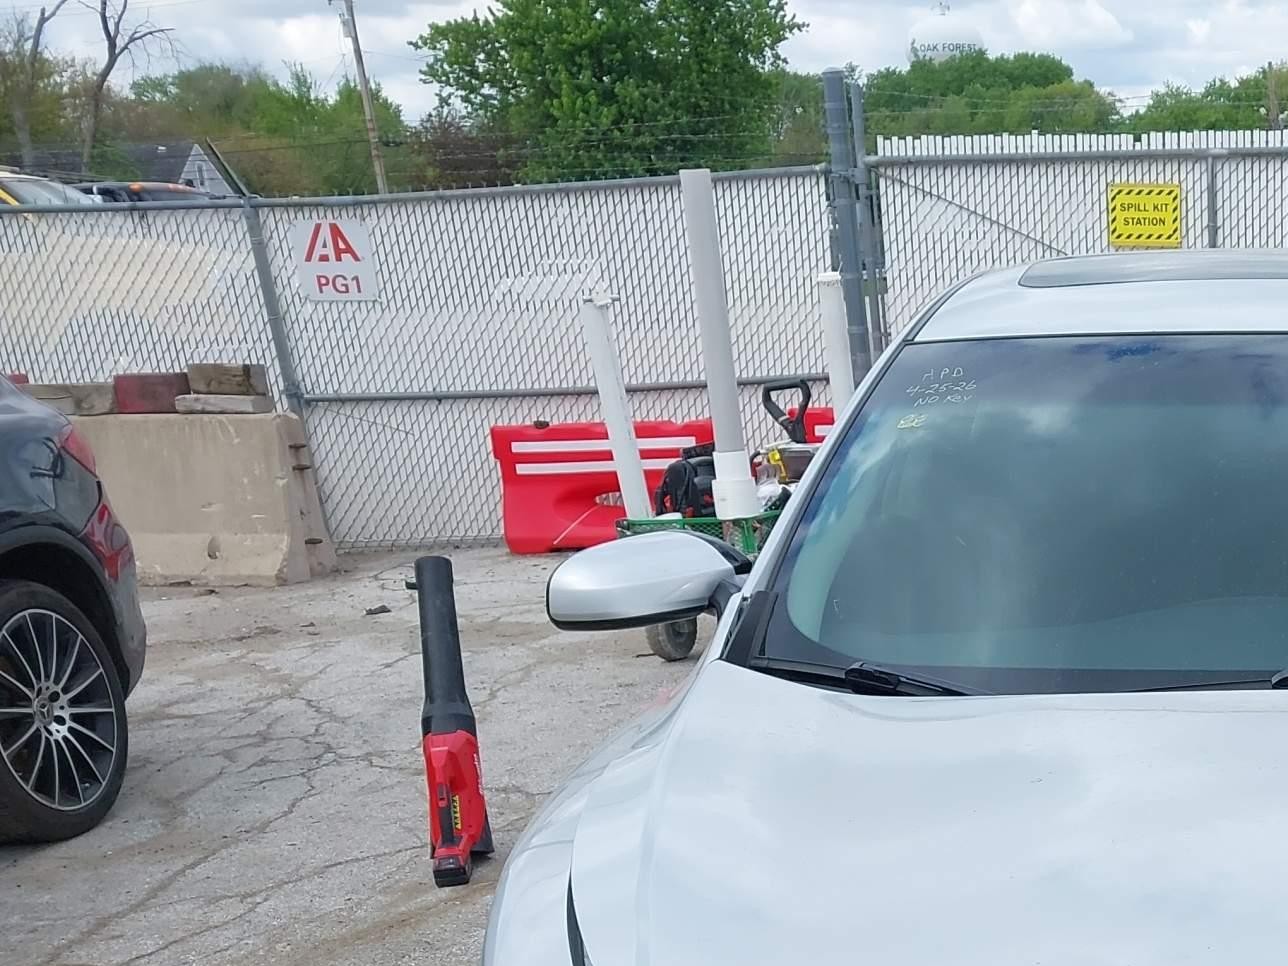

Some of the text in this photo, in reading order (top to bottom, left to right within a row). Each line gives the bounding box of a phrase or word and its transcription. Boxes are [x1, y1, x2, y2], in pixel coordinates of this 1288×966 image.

[919, 43, 977, 54] OAK FOREST
[1119, 202, 1170, 212] SPILL KIT
[1123, 216, 1167, 227] STATION
[315, 274, 362, 294] PG1
